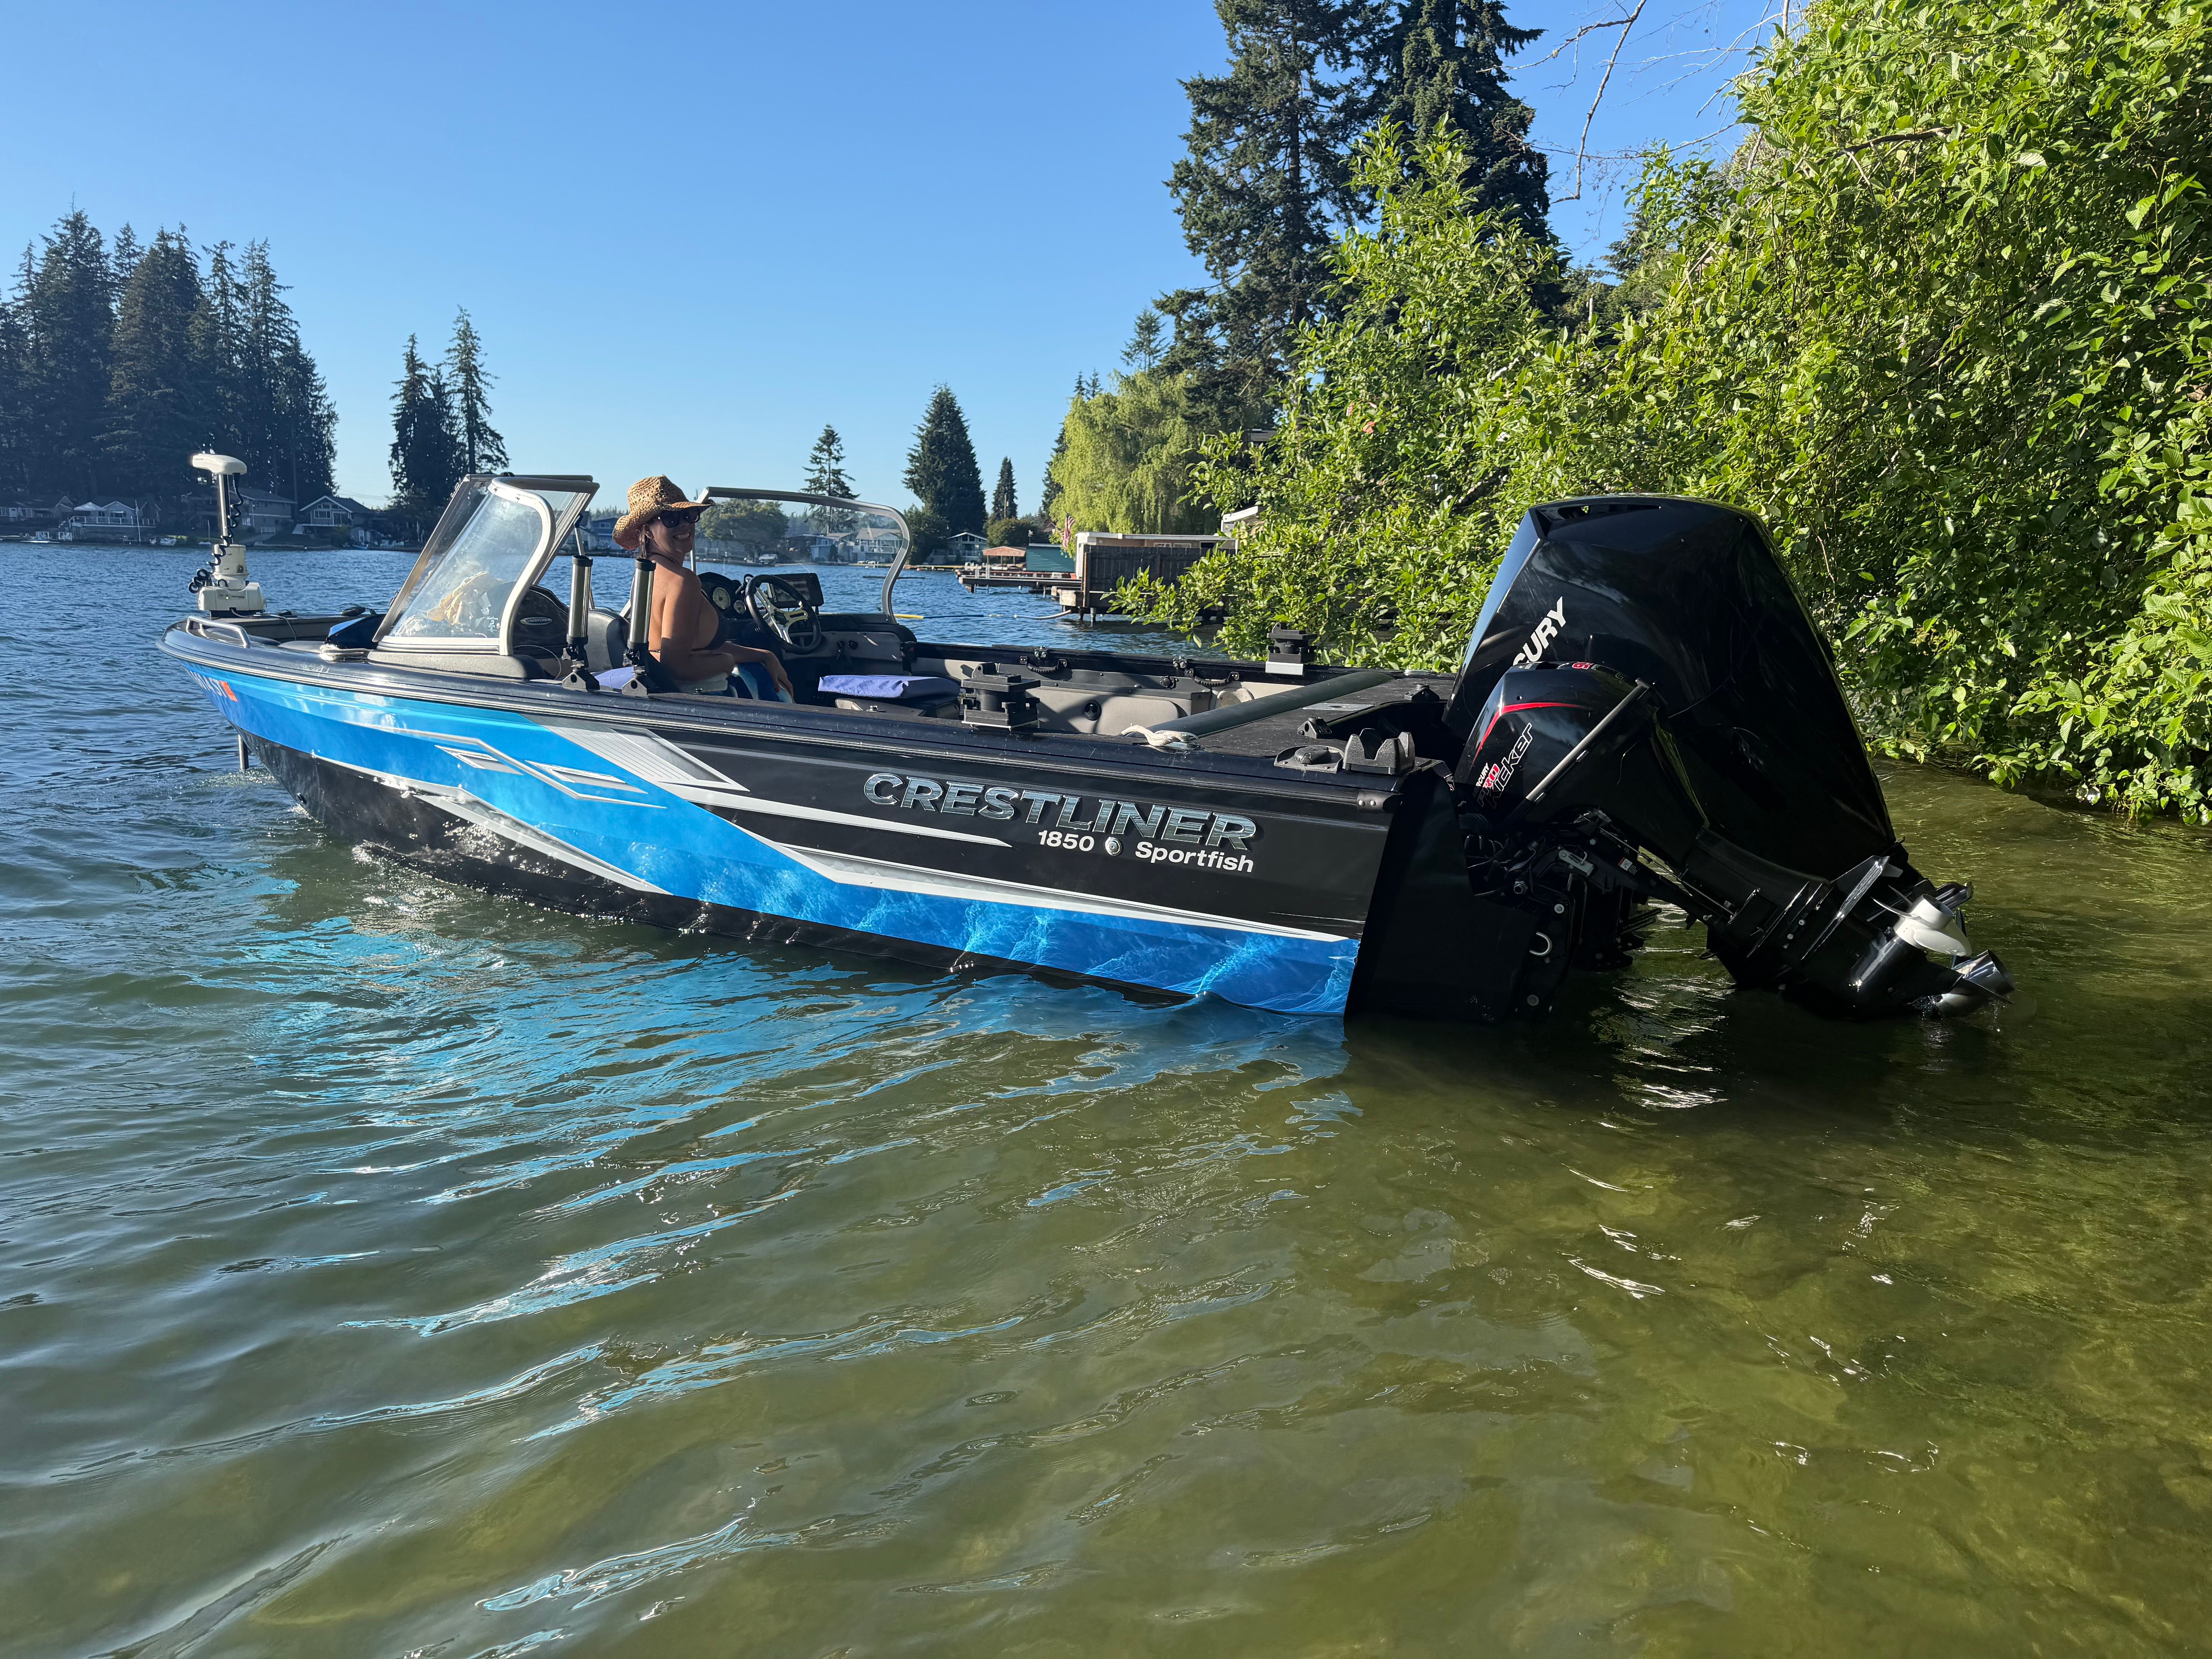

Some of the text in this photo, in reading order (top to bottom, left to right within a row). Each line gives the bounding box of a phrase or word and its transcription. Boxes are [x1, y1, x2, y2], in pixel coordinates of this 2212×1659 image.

[1477, 764, 1500, 807] PRO
[864, 773, 1257, 850] CRESTLINER
[1038, 830, 1254, 872] 1850 Sportfish
